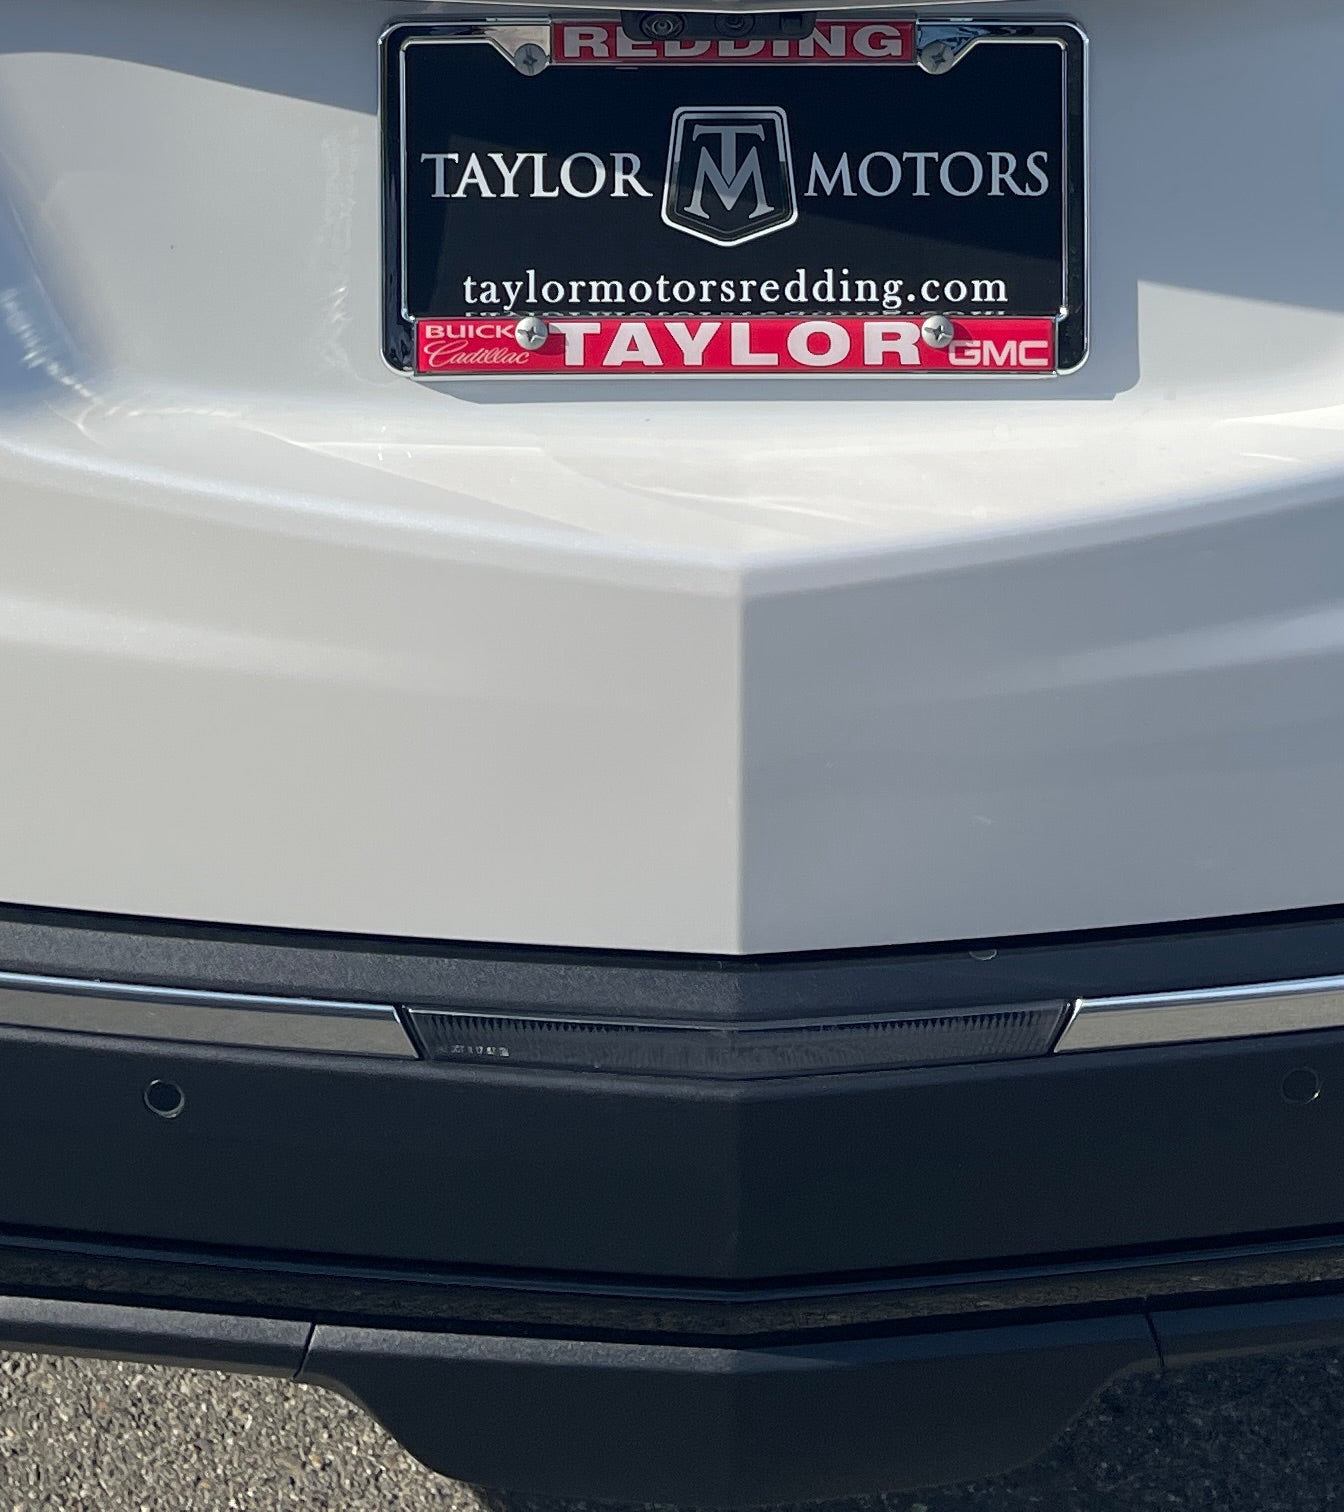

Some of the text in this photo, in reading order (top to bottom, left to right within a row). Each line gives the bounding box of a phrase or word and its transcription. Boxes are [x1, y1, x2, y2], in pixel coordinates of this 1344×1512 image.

[420, 151, 1049, 198] TAYLOR MOTORS
[463, 268, 1009, 311] taylormotorsredding.com
[425, 324, 517, 339] BUICK
[549, 321, 921, 366] TAYLOR
[423, 339, 530, 368] Cadillac
[948, 339, 1048, 366] GMC
